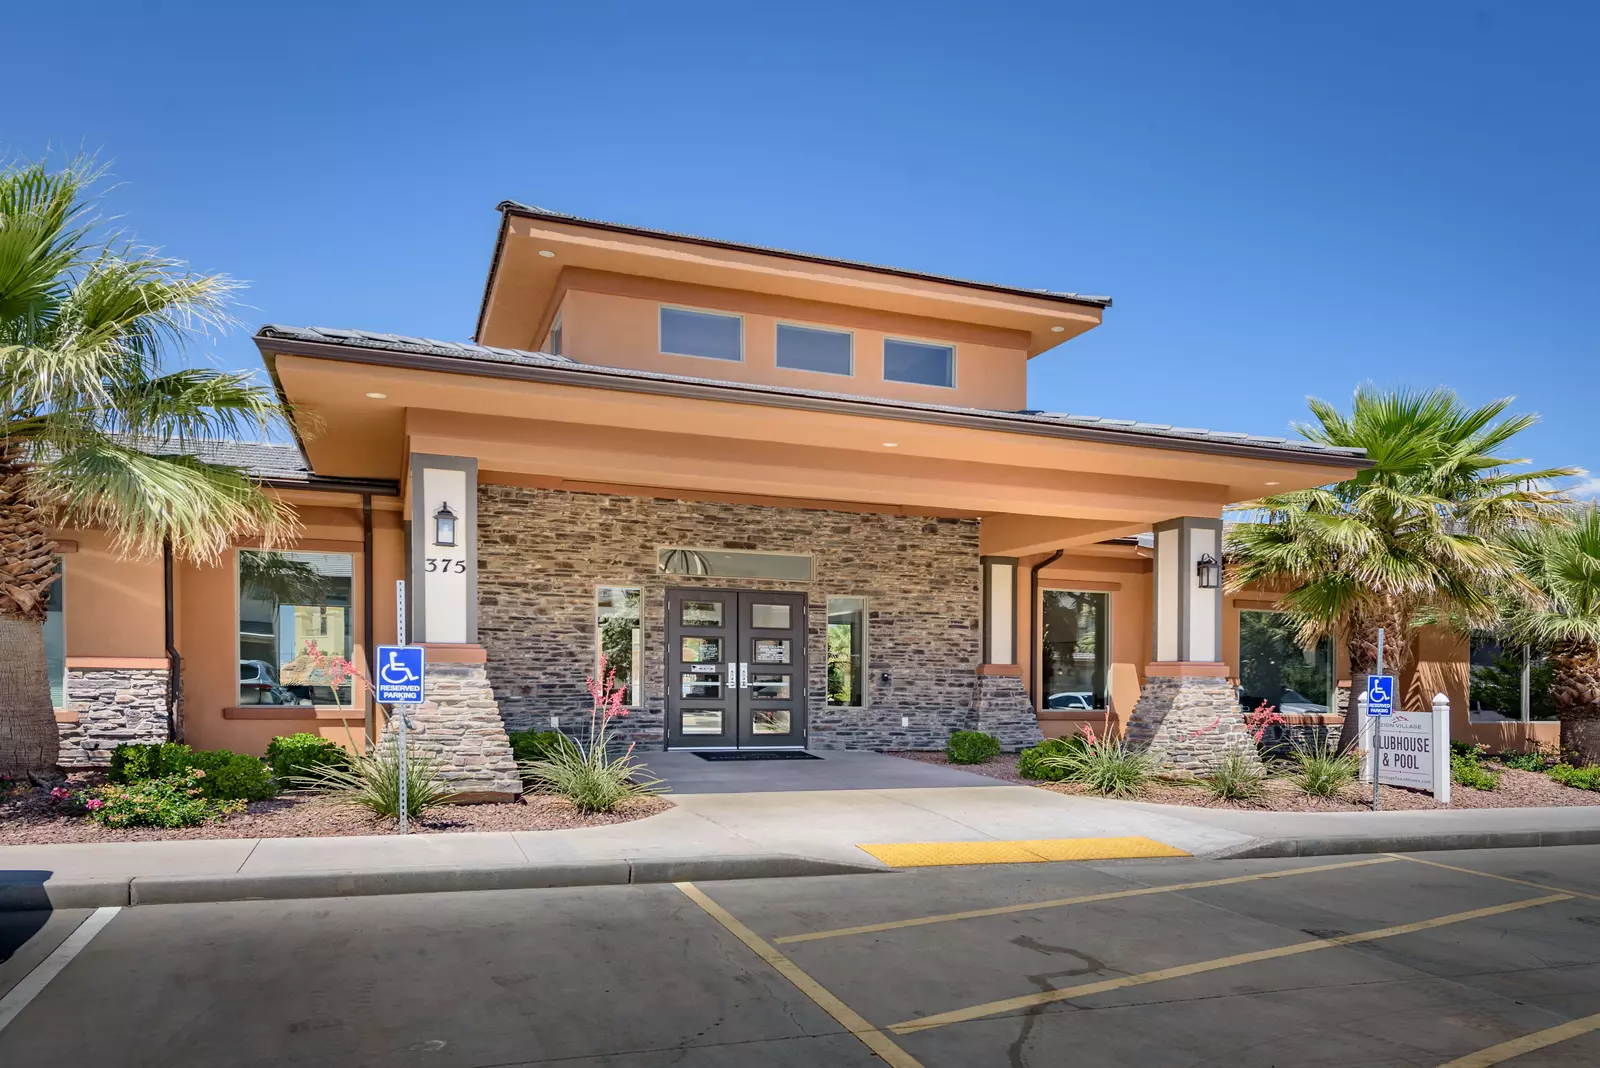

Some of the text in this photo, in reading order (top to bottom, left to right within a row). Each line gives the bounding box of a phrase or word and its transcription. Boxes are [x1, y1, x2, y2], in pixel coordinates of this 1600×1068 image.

[424, 558, 467, 574] 375
[379, 684, 421, 692] RESERVED
[383, 691, 417, 699] PARKING
[1382, 752, 1419, 769] & POOL
